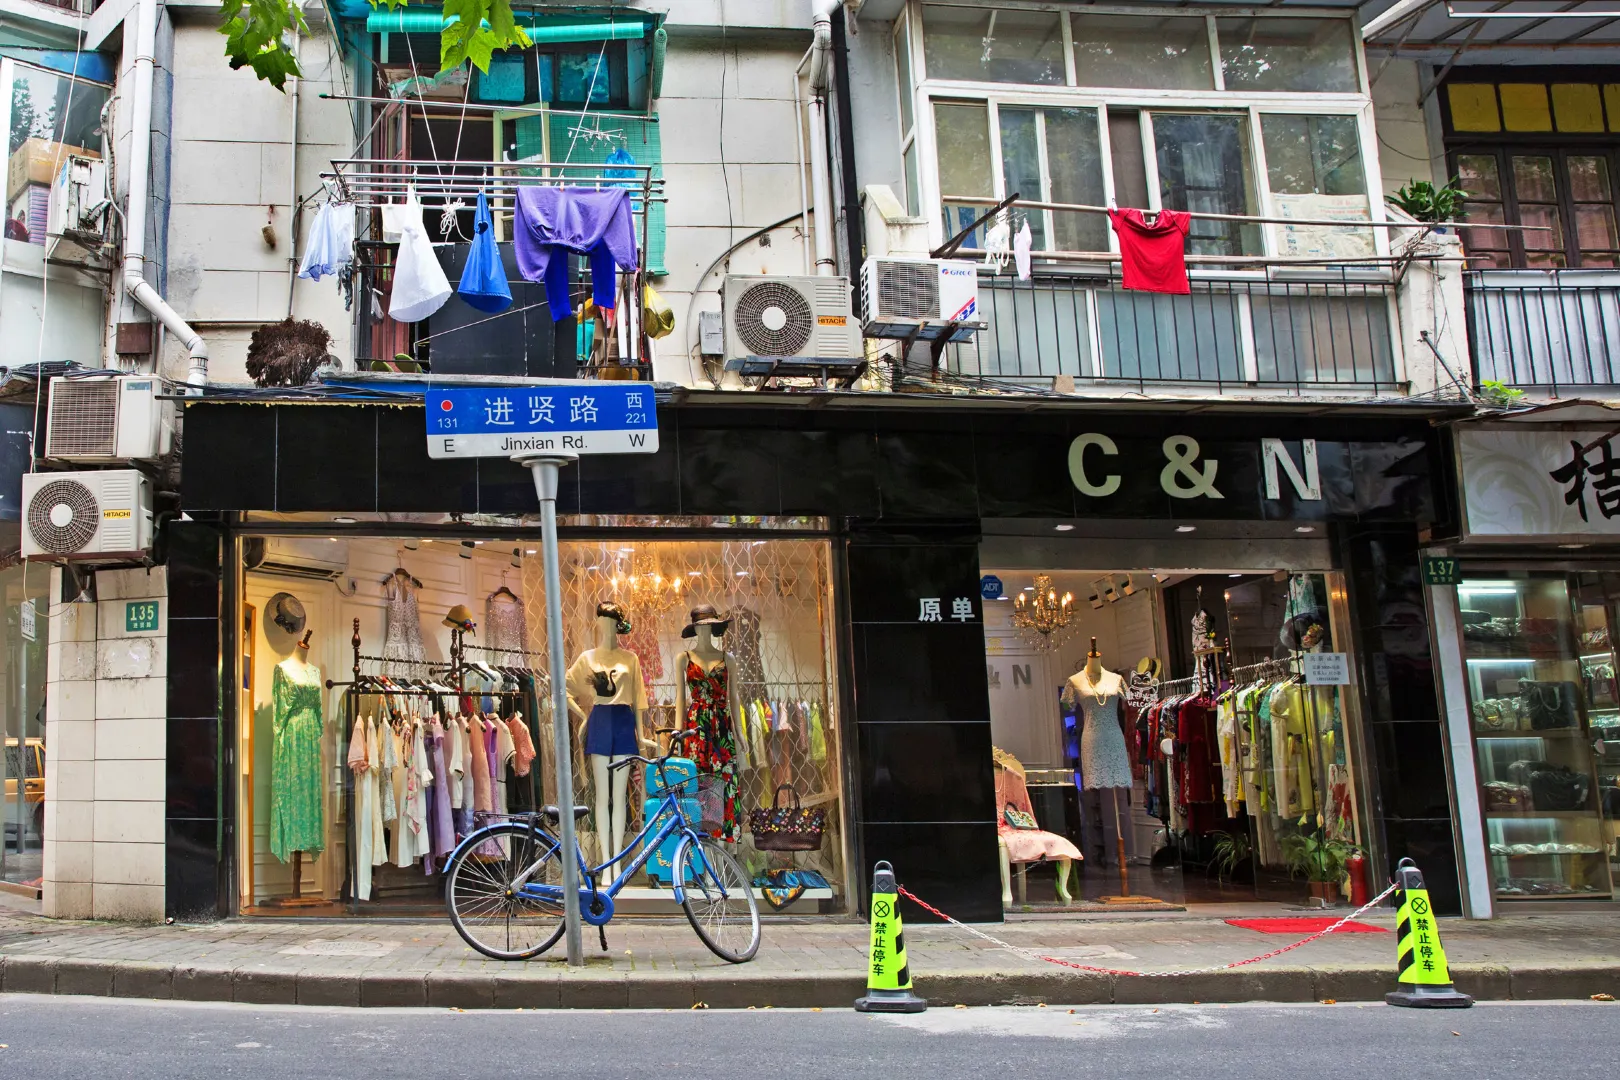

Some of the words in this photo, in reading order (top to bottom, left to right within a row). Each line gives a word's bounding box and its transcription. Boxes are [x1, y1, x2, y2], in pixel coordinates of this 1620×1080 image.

[818, 317, 847, 325] HITACHI
[625, 392, 643, 409] 西
[484, 395, 599, 425] 进贤路
[625, 413, 647, 424] 221
[437, 418, 458, 429] 131
[443, 439, 456, 453] E
[501, 436, 554, 451] Jinxian
[562, 435, 588, 449] Rd.
[629, 434, 646, 448] W
[1068, 433, 1121, 497] C
[1160, 434, 1225, 499] &
[1261, 437, 1322, 500] N
[1428, 561, 1454, 575] 137
[983, 582, 999, 592] ADT
[130, 605, 154, 621] 135
[918, 597, 975, 622] 原单
[873, 921, 887, 976] 禁止停车
[1416, 918, 1435, 972] 禁止停车
